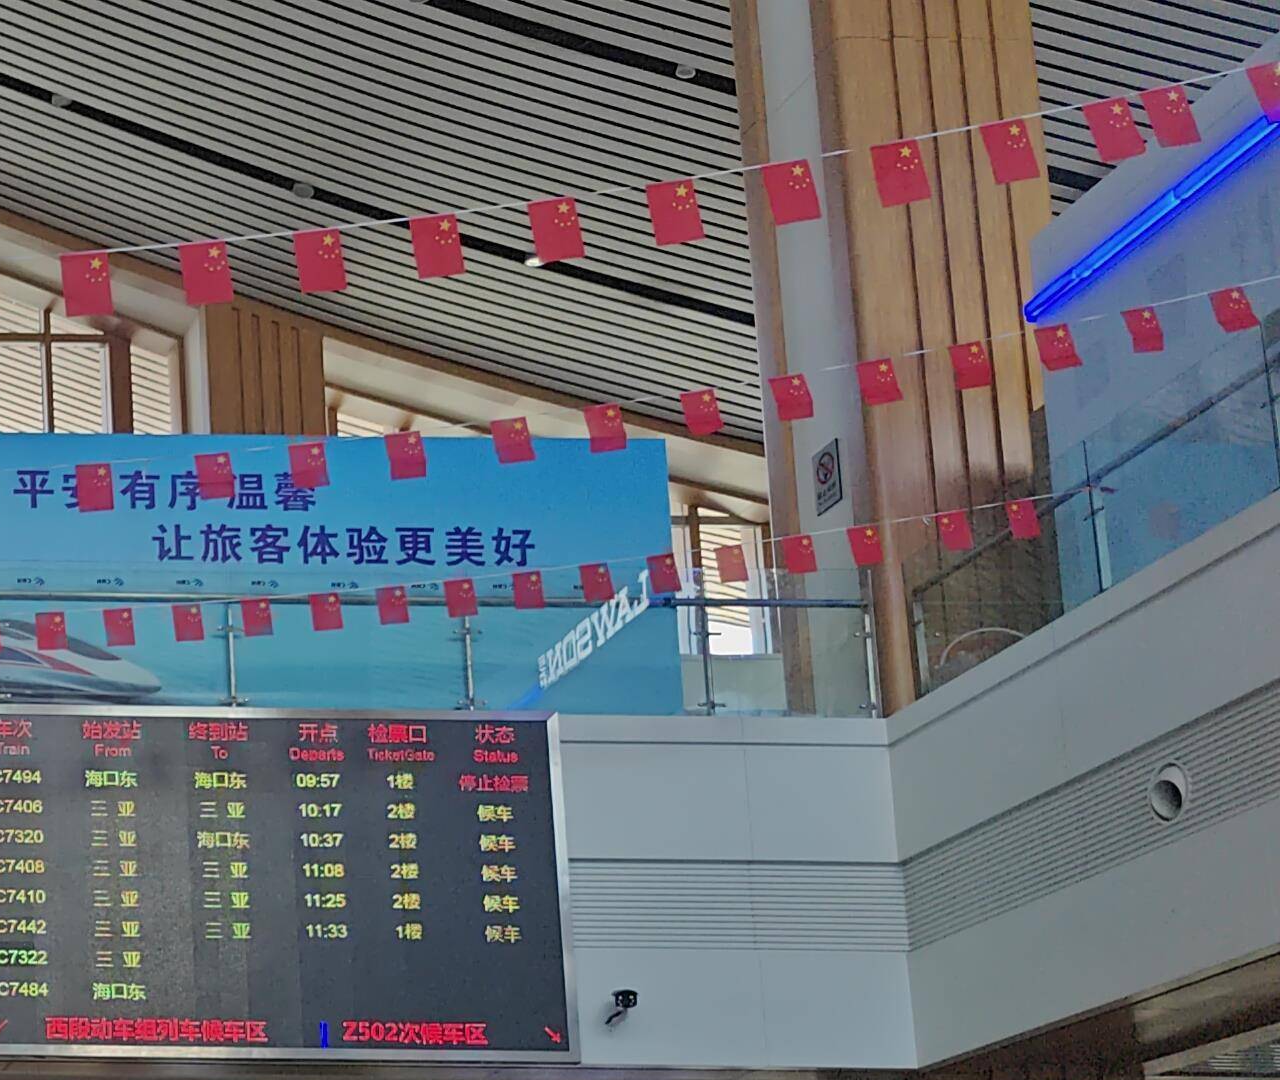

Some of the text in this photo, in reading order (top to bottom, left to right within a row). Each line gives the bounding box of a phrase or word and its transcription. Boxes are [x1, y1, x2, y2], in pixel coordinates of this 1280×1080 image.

[227, 472, 317, 511] 温馨
[152, 523, 536, 567] 让旅客体验更美好
[82, 721, 142, 740] 始发站
[188, 722, 248, 742] 终到站
[299, 723, 338, 743] 开点
[368, 724, 427, 743] 检票口
[475, 725, 514, 743] 状态
[94, 743, 132, 757] From
[211, 746, 228, 760] To
[473, 749, 518, 764] Status
[85, 770, 137, 789] 海口东
[194, 770, 247, 790] 海口东
[296, 773, 339, 789] 09:57
[298, 803, 342, 819] 10:17
[197, 831, 250, 850] 海口东
[299, 833, 343, 849] 10:37
[302, 863, 344, 879] 11:08
[304, 893, 346, 909] 11:25
[305, 923, 347, 940] 11:33
[93, 982, 146, 1001] 海口东
[45, 1017, 268, 1042] 西段动车组列车候车区
[343, 1021, 488, 1045] Z502次候车区
